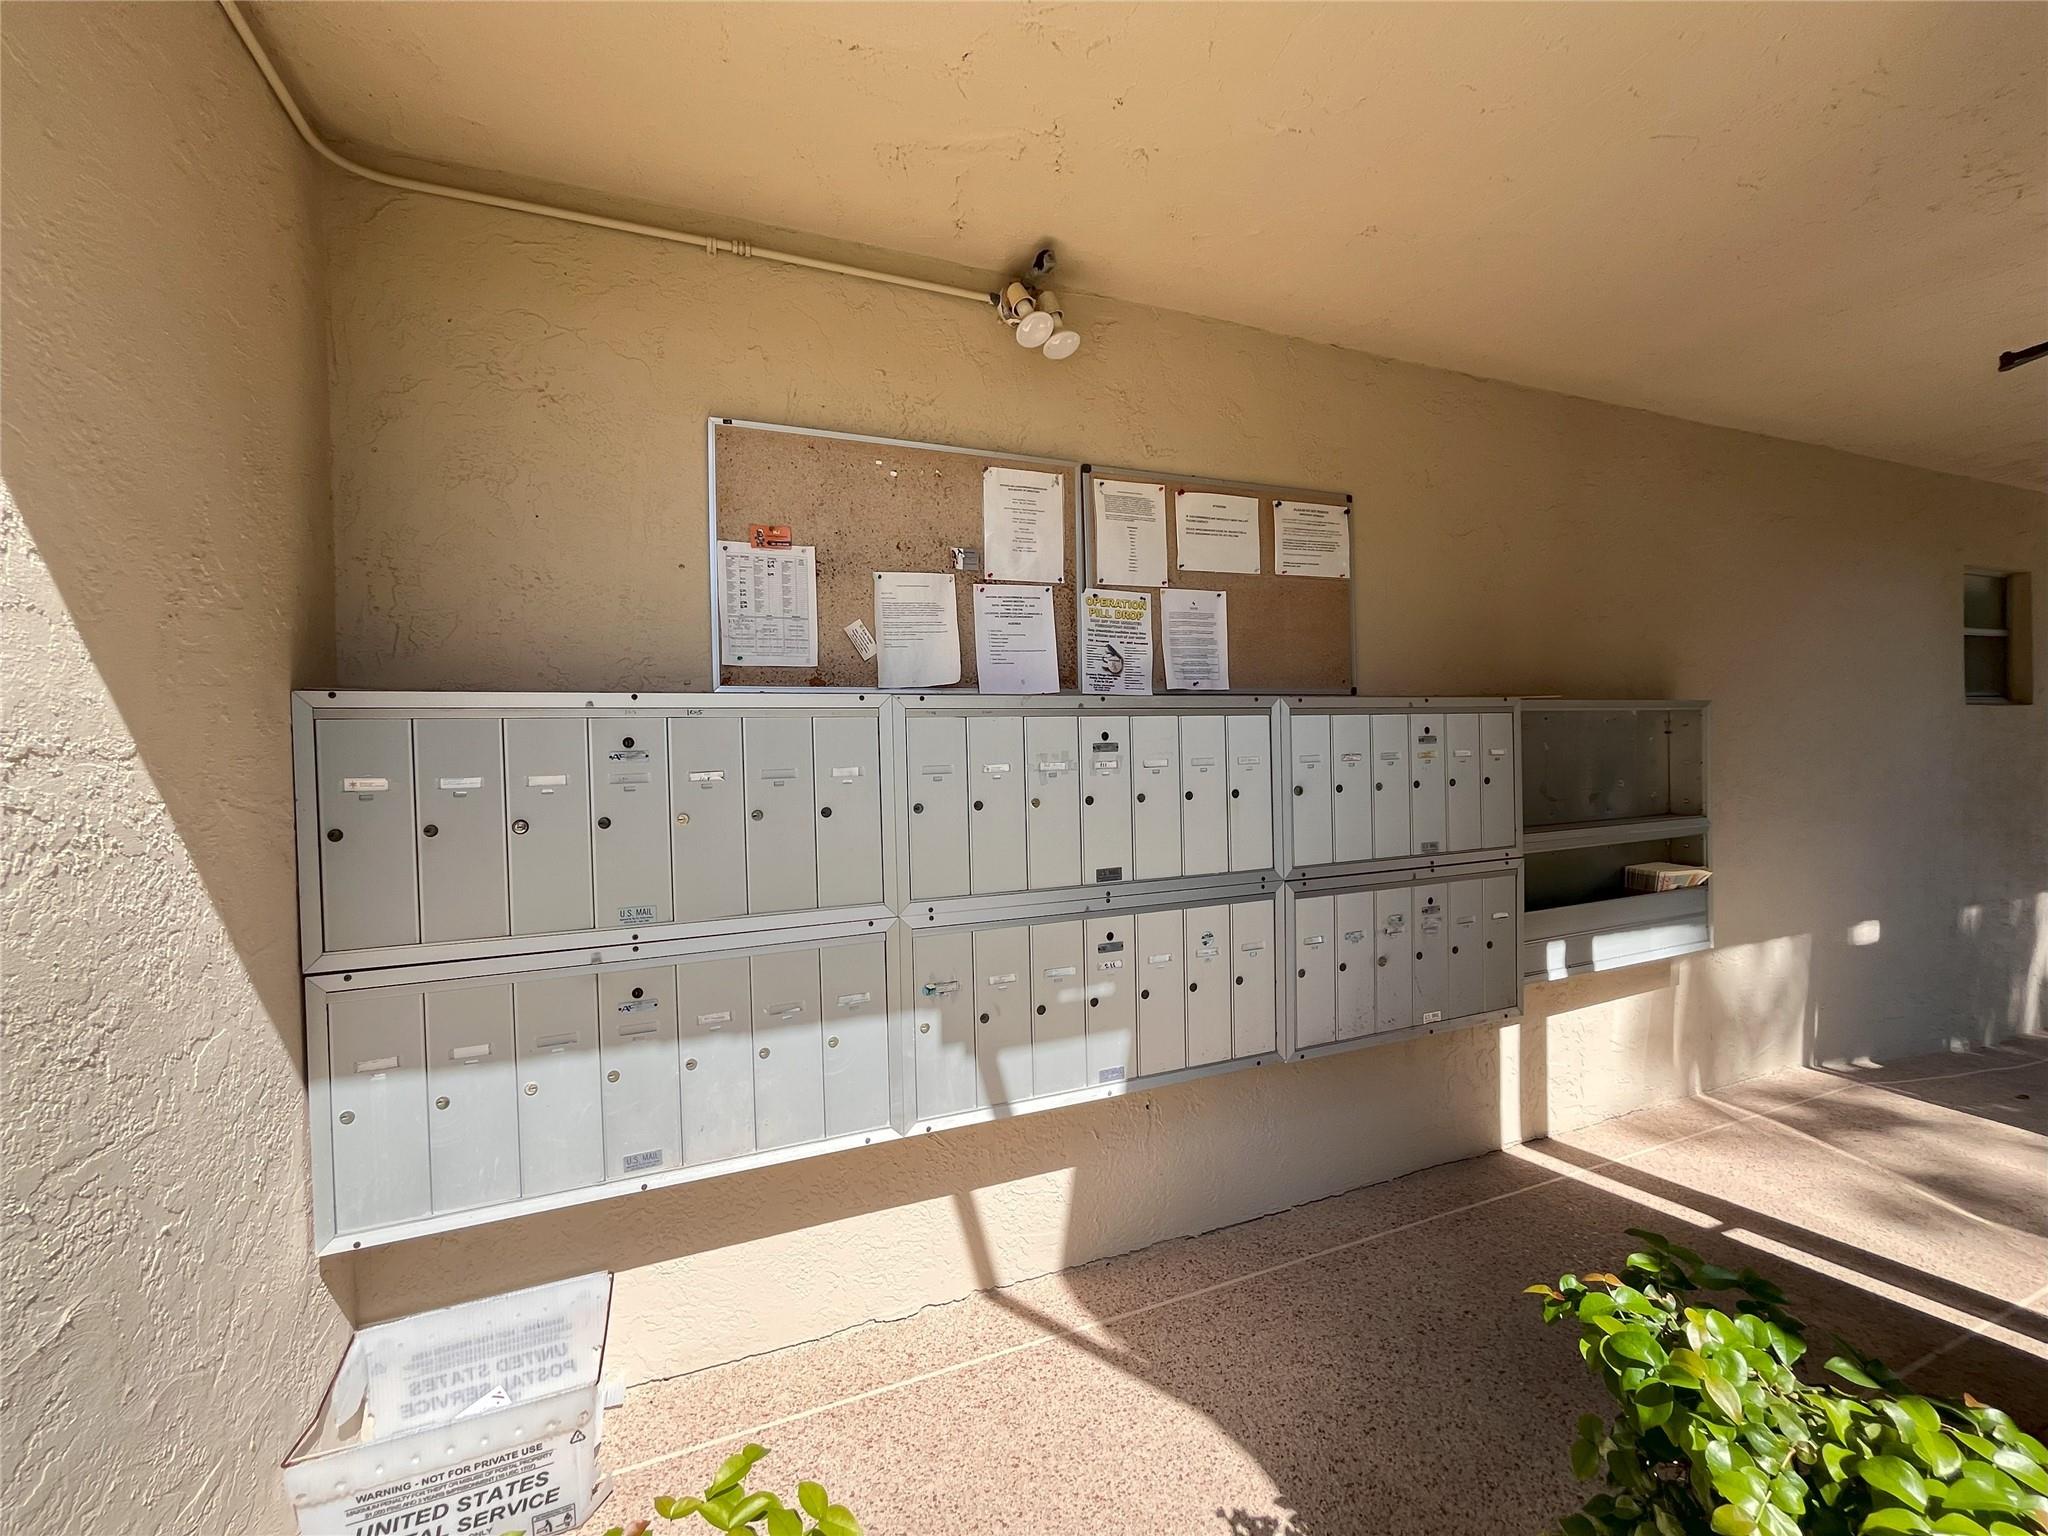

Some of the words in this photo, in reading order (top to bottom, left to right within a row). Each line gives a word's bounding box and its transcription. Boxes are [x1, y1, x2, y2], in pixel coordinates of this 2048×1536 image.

[1086, 597, 1147, 611] OPERATION
[1088, 607, 1112, 619] PILL
[1114, 610, 1143, 621] DROP
[636, 907, 653, 916] MAIL
[642, 1151, 659, 1162] MAIL
[355, 1482, 412, 1503] WARNING
[421, 1472, 445, 1486] NOT
[447, 1466, 471, 1478] FOR
[474, 1450, 519, 1471] PRIVATE
[521, 1442, 543, 1456] USE
[356, 1503, 450, 1536] UNITED
[457, 1471, 549, 1512] STATES
[457, 1487, 560, 1532] SERVICE
